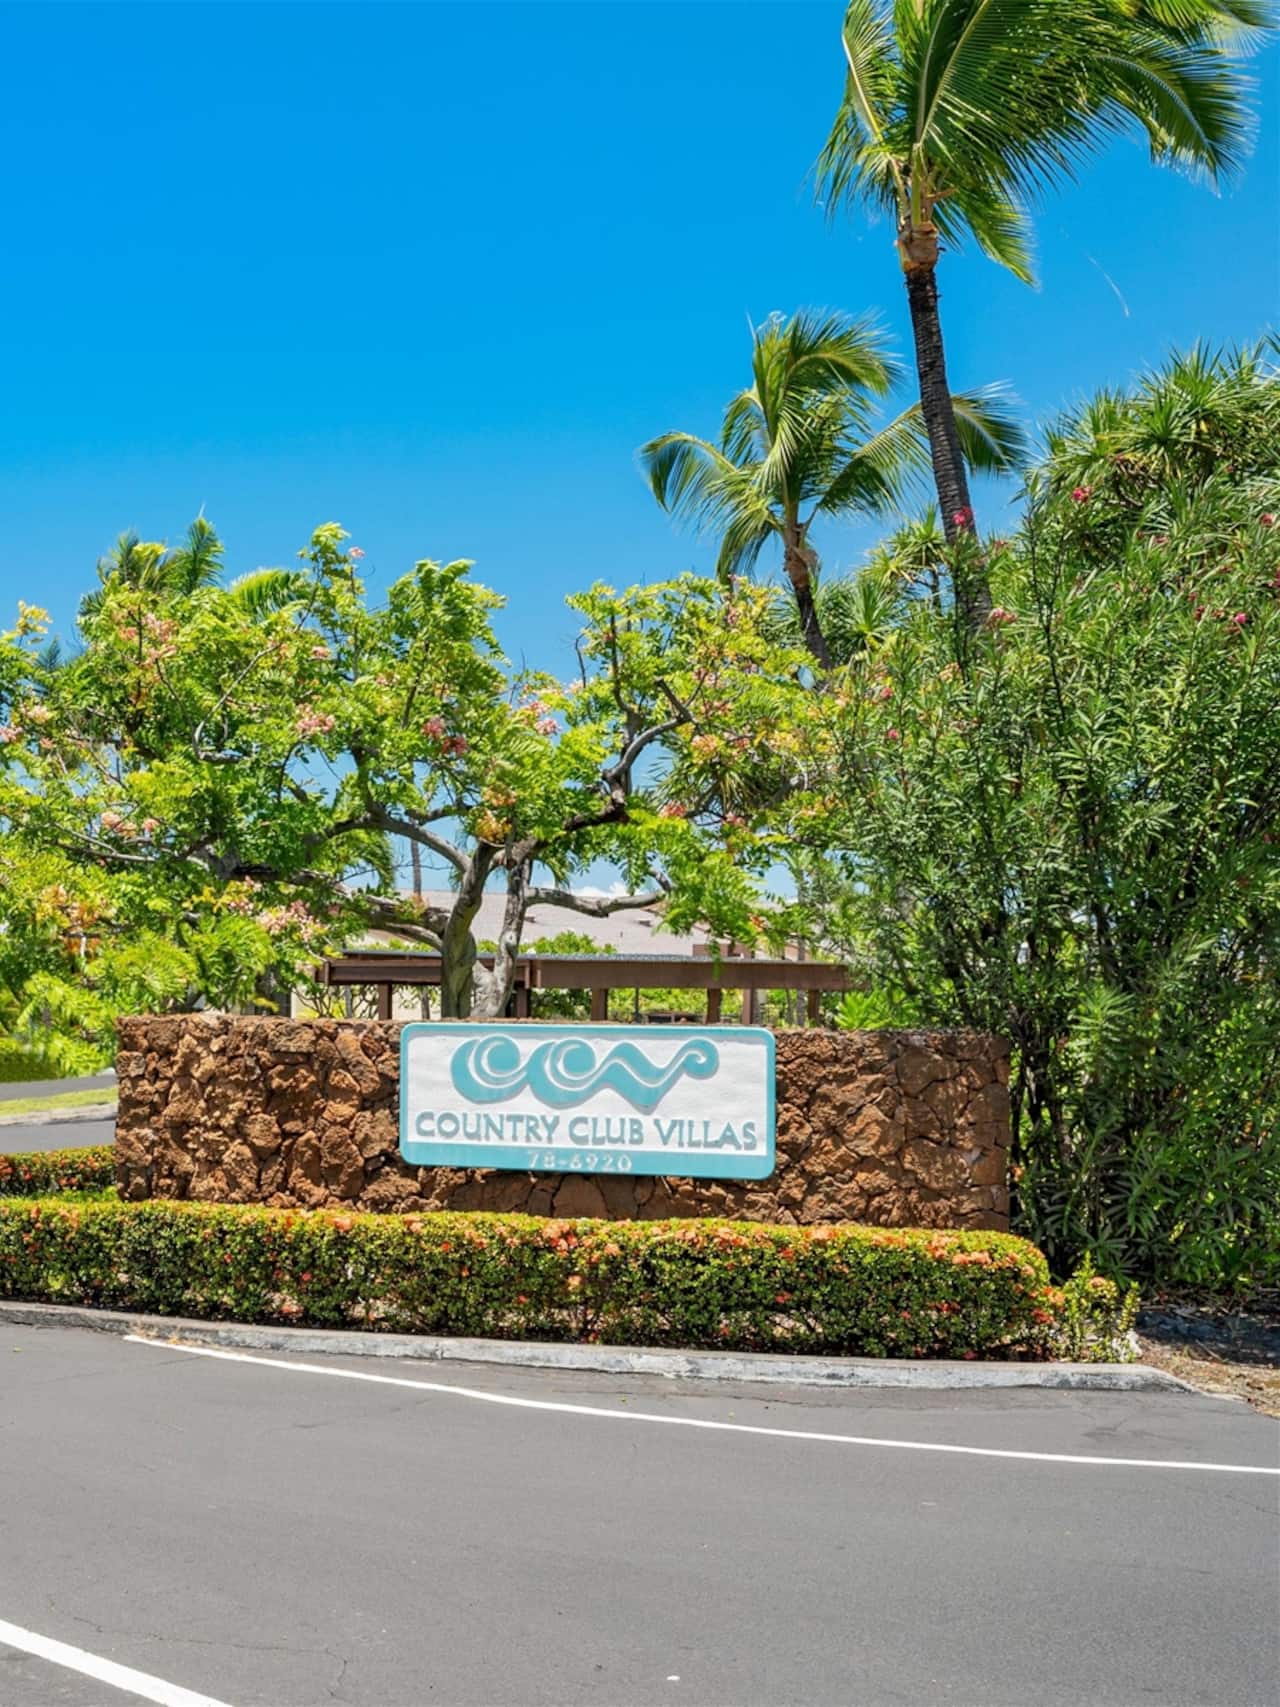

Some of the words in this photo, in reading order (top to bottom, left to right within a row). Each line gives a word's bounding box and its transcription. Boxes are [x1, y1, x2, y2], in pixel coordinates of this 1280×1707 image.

[415, 1111, 560, 1142] COUNTRY
[568, 1118, 644, 1146] CLUB
[654, 1119, 757, 1150] VILLAS
[528, 1150, 632, 1171] 78-6920
